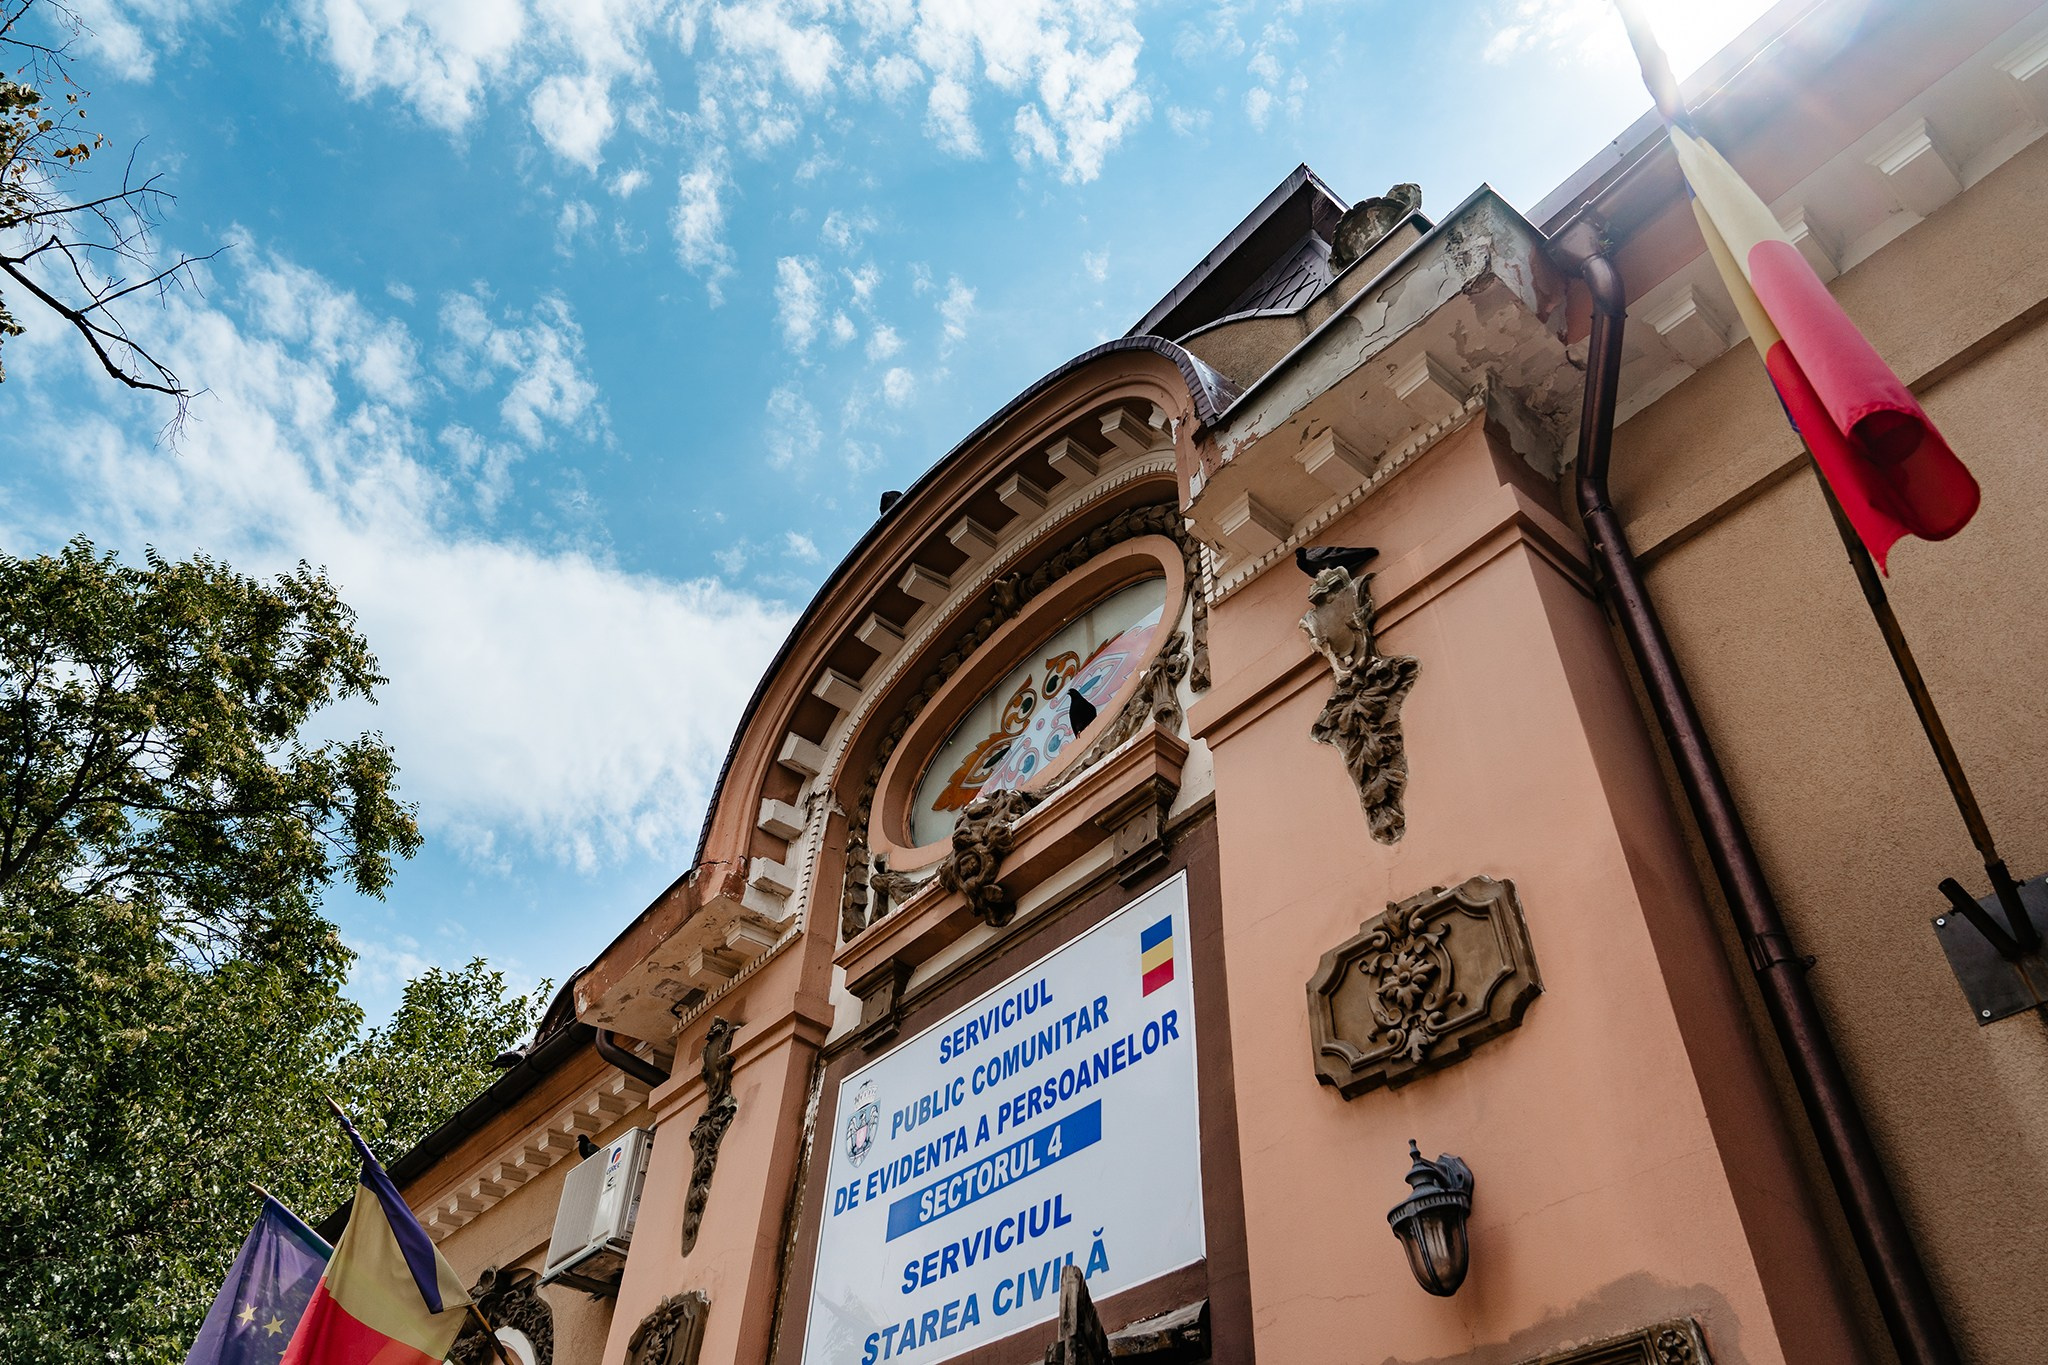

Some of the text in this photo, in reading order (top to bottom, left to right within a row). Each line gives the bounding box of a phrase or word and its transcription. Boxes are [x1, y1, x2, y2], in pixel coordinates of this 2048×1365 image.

[891, 995, 1109, 1140] PUBLIC COMUNITAR
[939, 978, 1054, 1065] SERVICIUL
[833, 1009, 1180, 1217] DE EVIDENTA A PERSOANELOR
[918, 1124, 1063, 1222] SECTORUL 4
[901, 1193, 1073, 1295] SERVICIUL
[861, 1292, 981, 1365] STAREA
